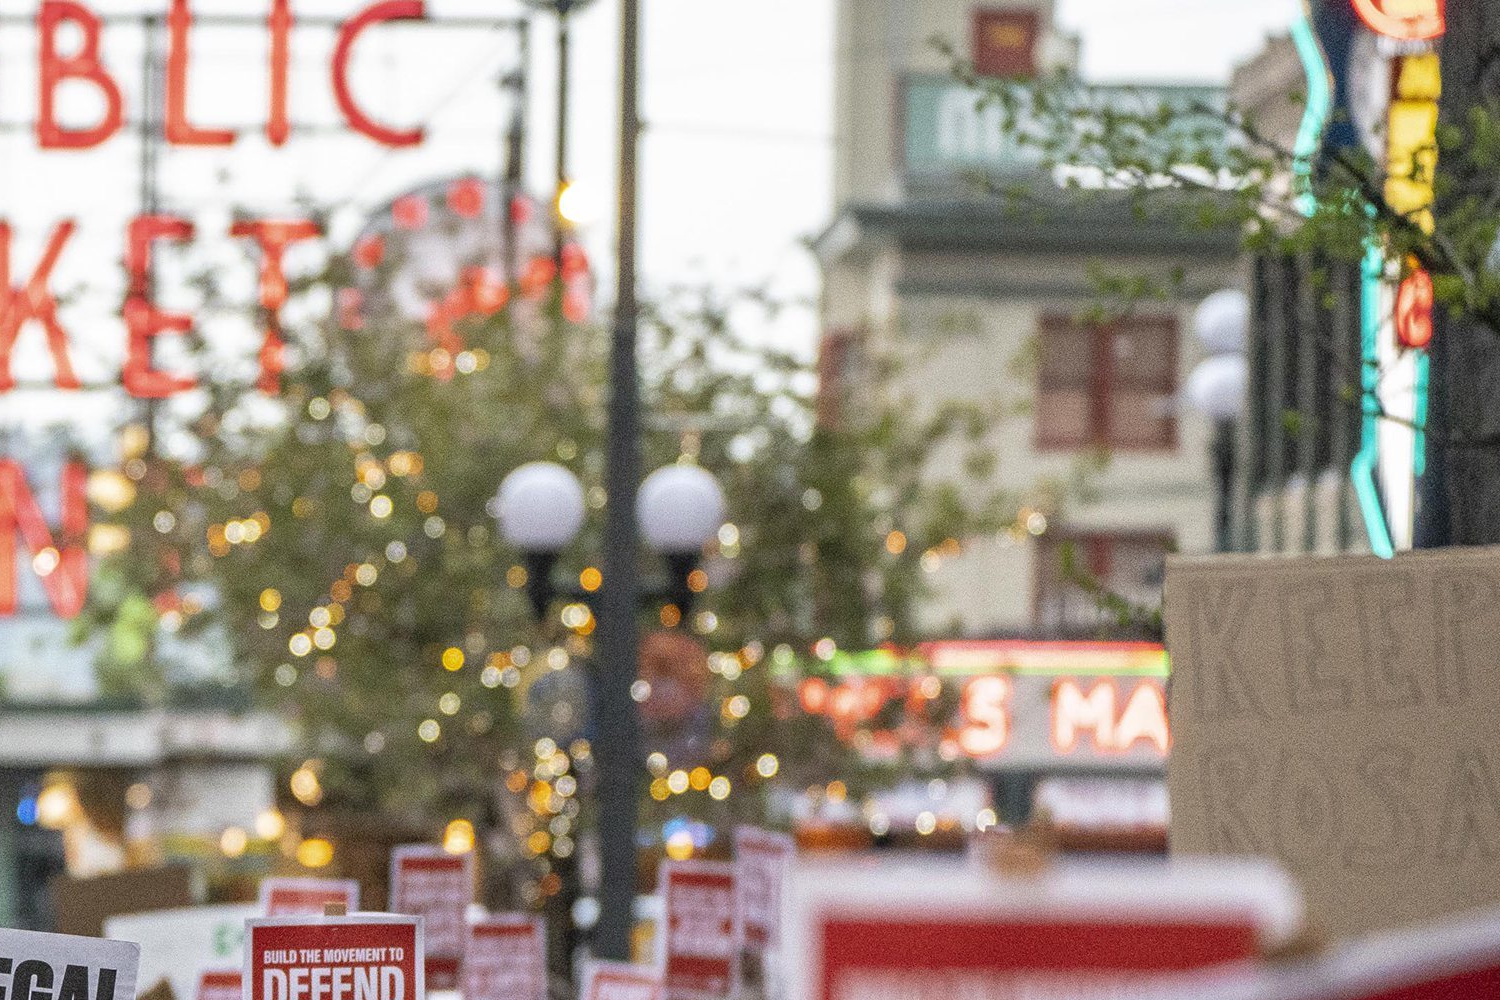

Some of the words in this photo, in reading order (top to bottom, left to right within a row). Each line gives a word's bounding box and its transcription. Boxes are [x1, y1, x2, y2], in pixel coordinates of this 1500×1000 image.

[263, 949, 297, 964] BUILD
[300, 949, 321, 963] THE
[323, 948, 386, 963] MOVEMENT
[389, 947, 405, 962] TO
